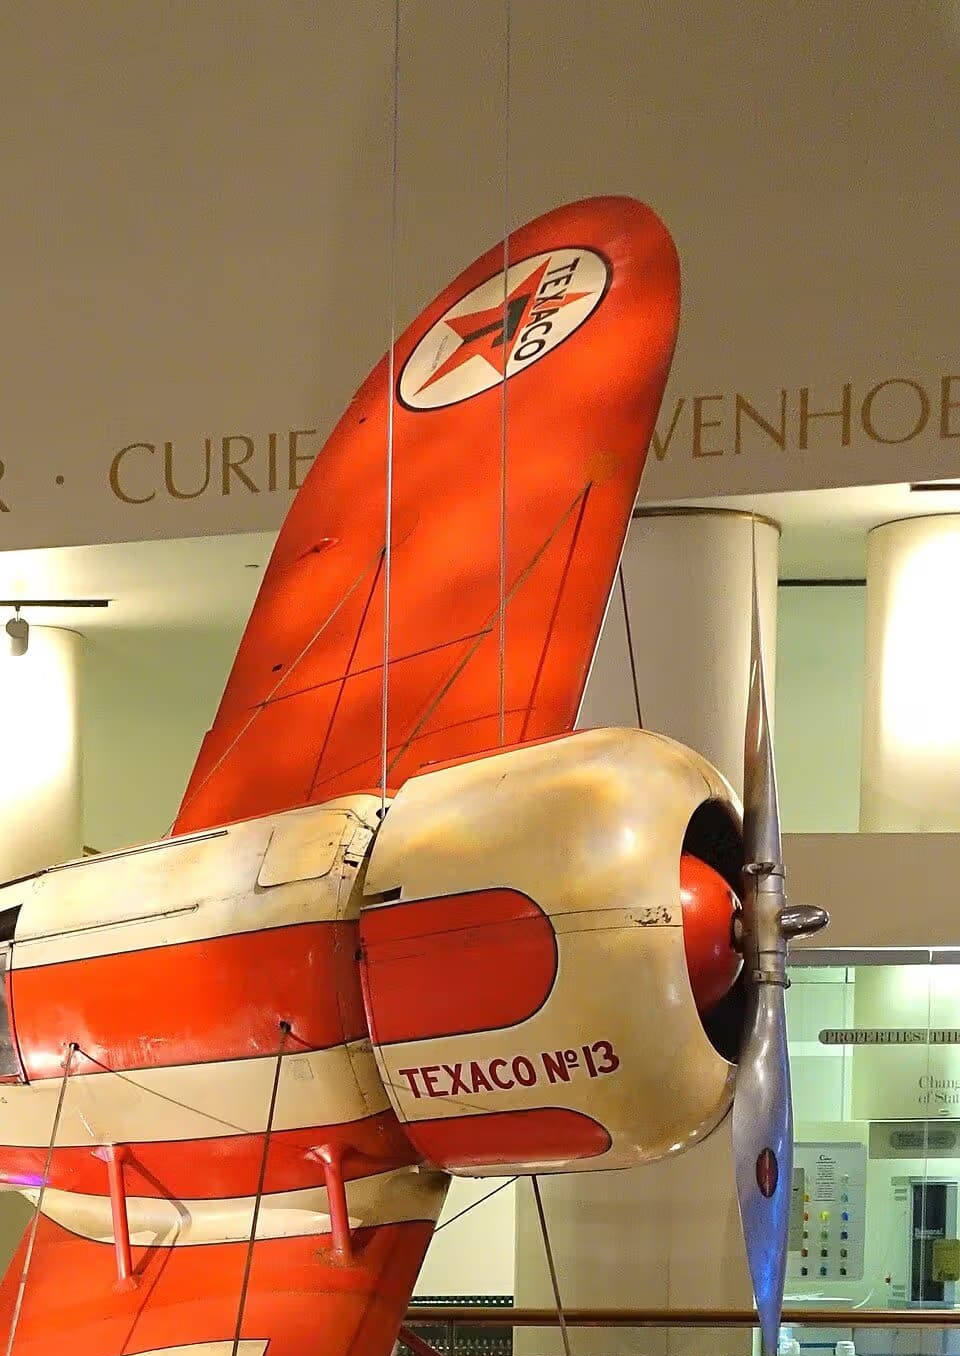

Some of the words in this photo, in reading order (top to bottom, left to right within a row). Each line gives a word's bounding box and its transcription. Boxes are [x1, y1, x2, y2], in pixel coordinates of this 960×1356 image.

[513, 255, 582, 362] TEXACO
[108, 428, 319, 505] CURIE
[398, 1055, 537, 1099] TEXACO
